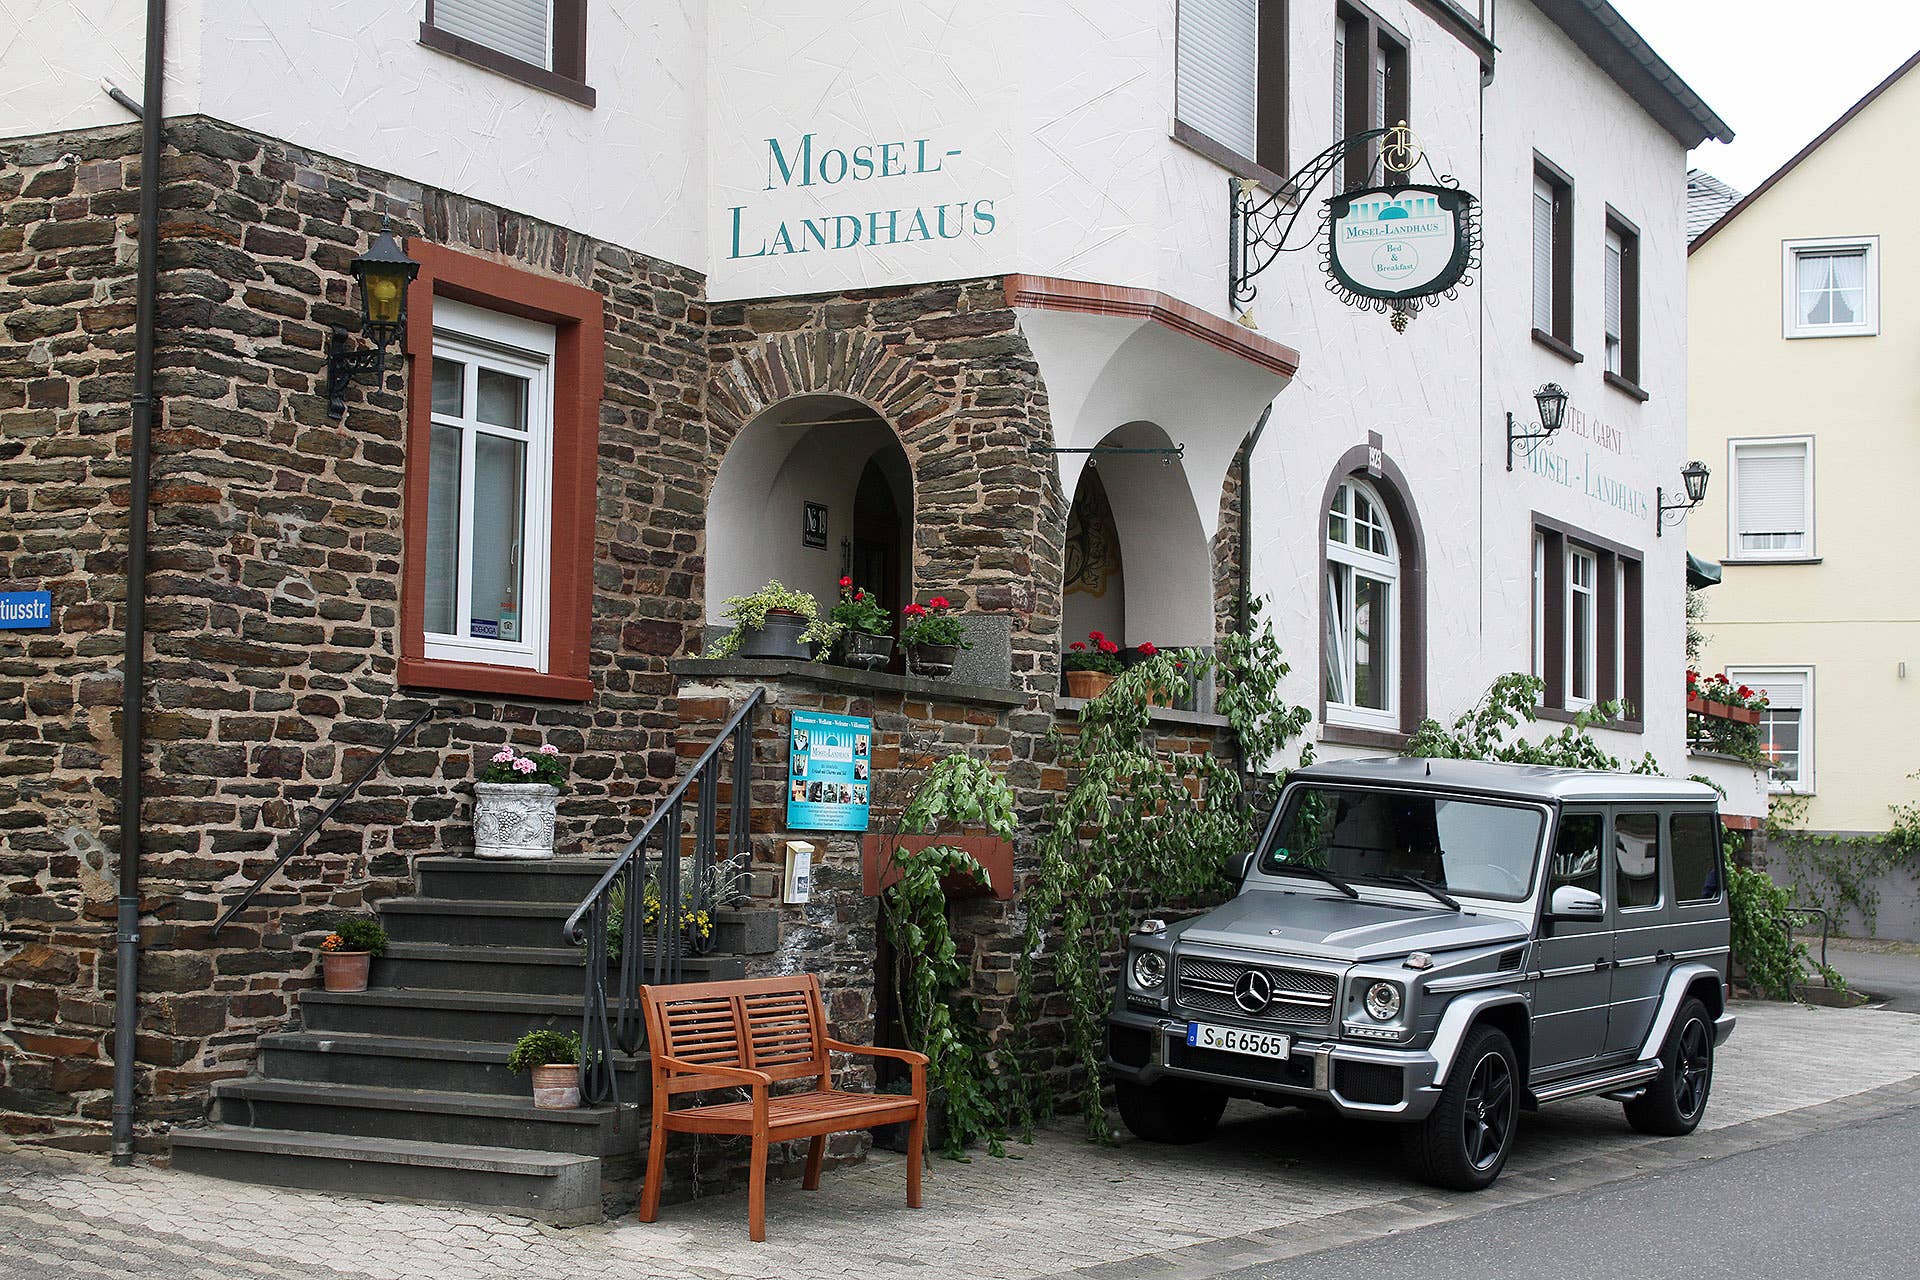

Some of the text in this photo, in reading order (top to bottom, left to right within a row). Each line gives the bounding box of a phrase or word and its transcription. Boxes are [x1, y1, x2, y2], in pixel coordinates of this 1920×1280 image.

[726, 199, 996, 260] LANDHAUS
[1387, 245, 1402, 253] Bed
[1390, 254, 1399, 262] &
[1376, 264, 1415, 273] Breakfast
[1561, 404, 1623, 456] OTEL GARNI
[1584, 449, 1649, 521] LANDHAUS
[0, 599, 49, 620] tiusstr.
